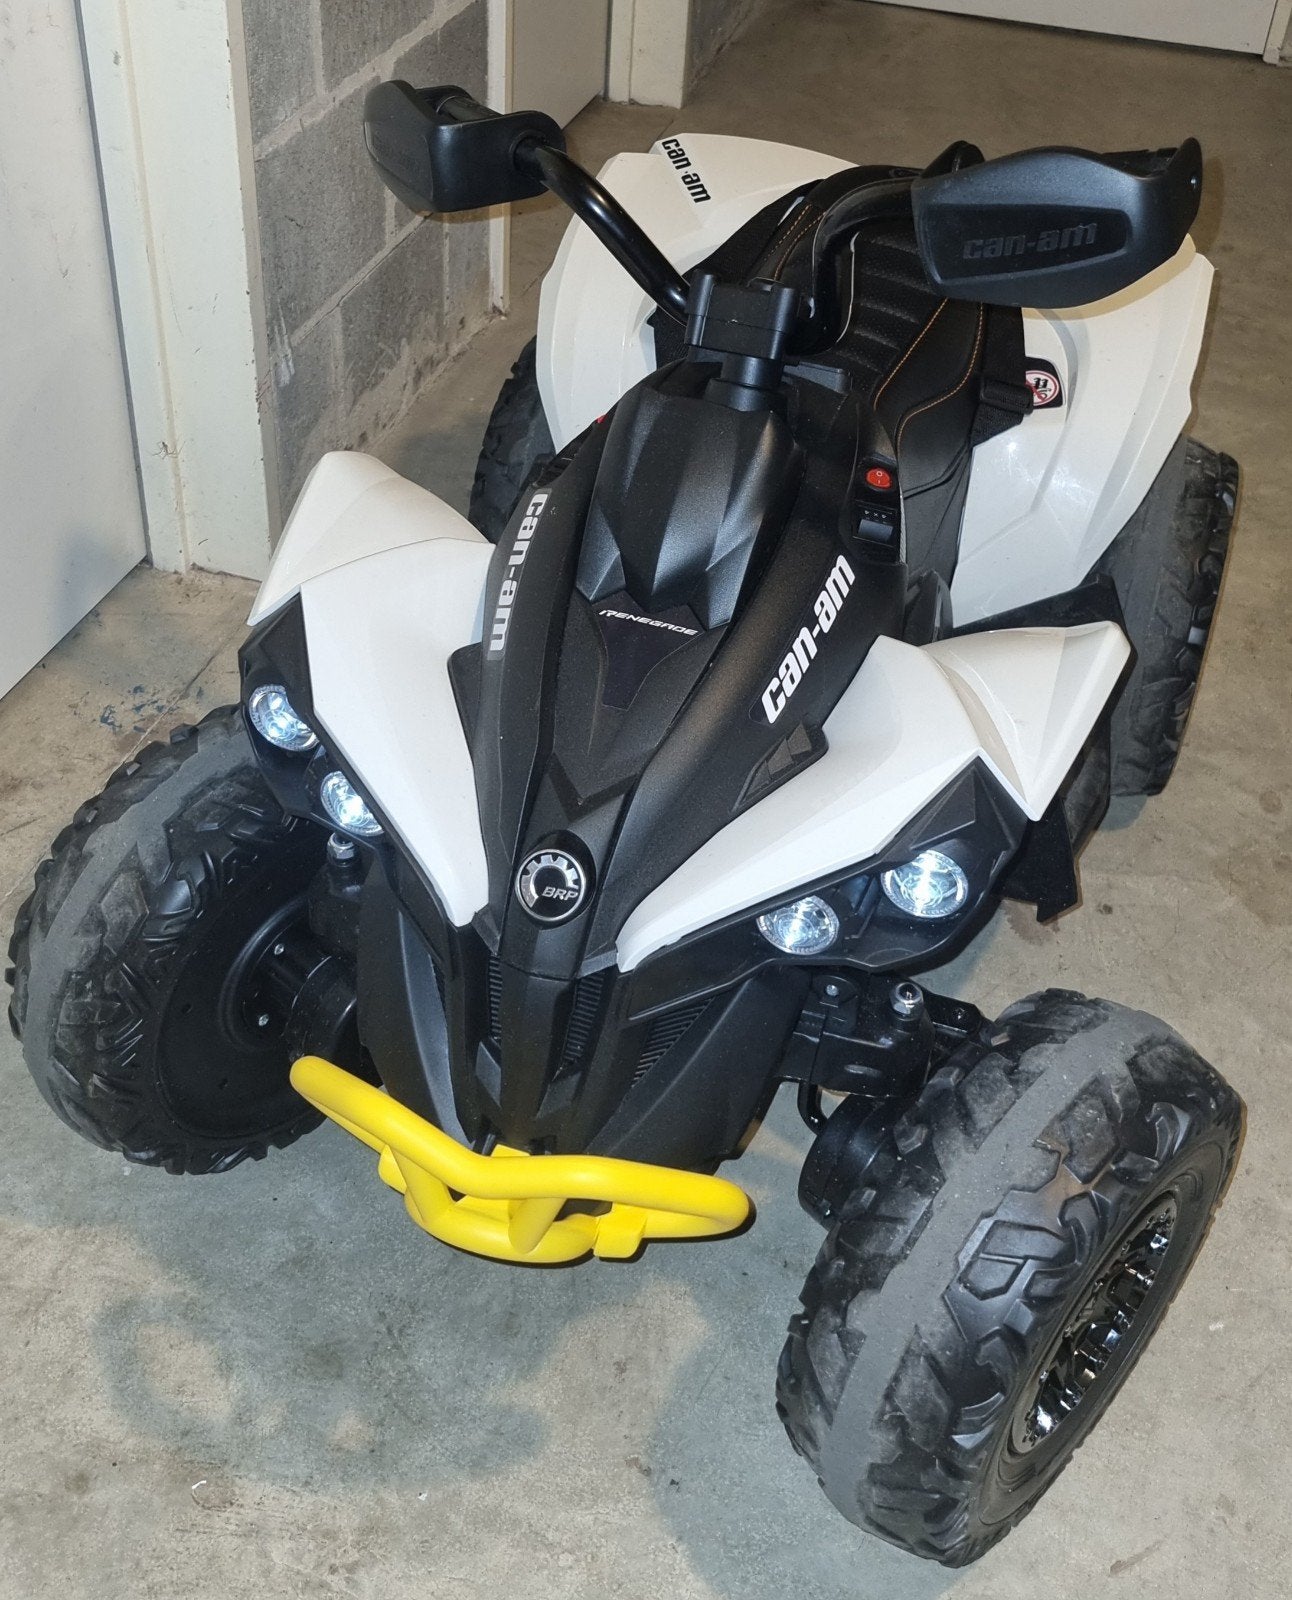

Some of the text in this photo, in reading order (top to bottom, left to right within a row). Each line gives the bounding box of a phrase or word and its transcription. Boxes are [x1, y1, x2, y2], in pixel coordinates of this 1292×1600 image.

[661, 138, 711, 203] can-am
[963, 222, 1098, 260] can-am
[489, 493, 549, 651] can-am
[599, 609, 699, 636] RENEGADE
[761, 554, 856, 724] can-am
[542, 886, 578, 901] BRP
